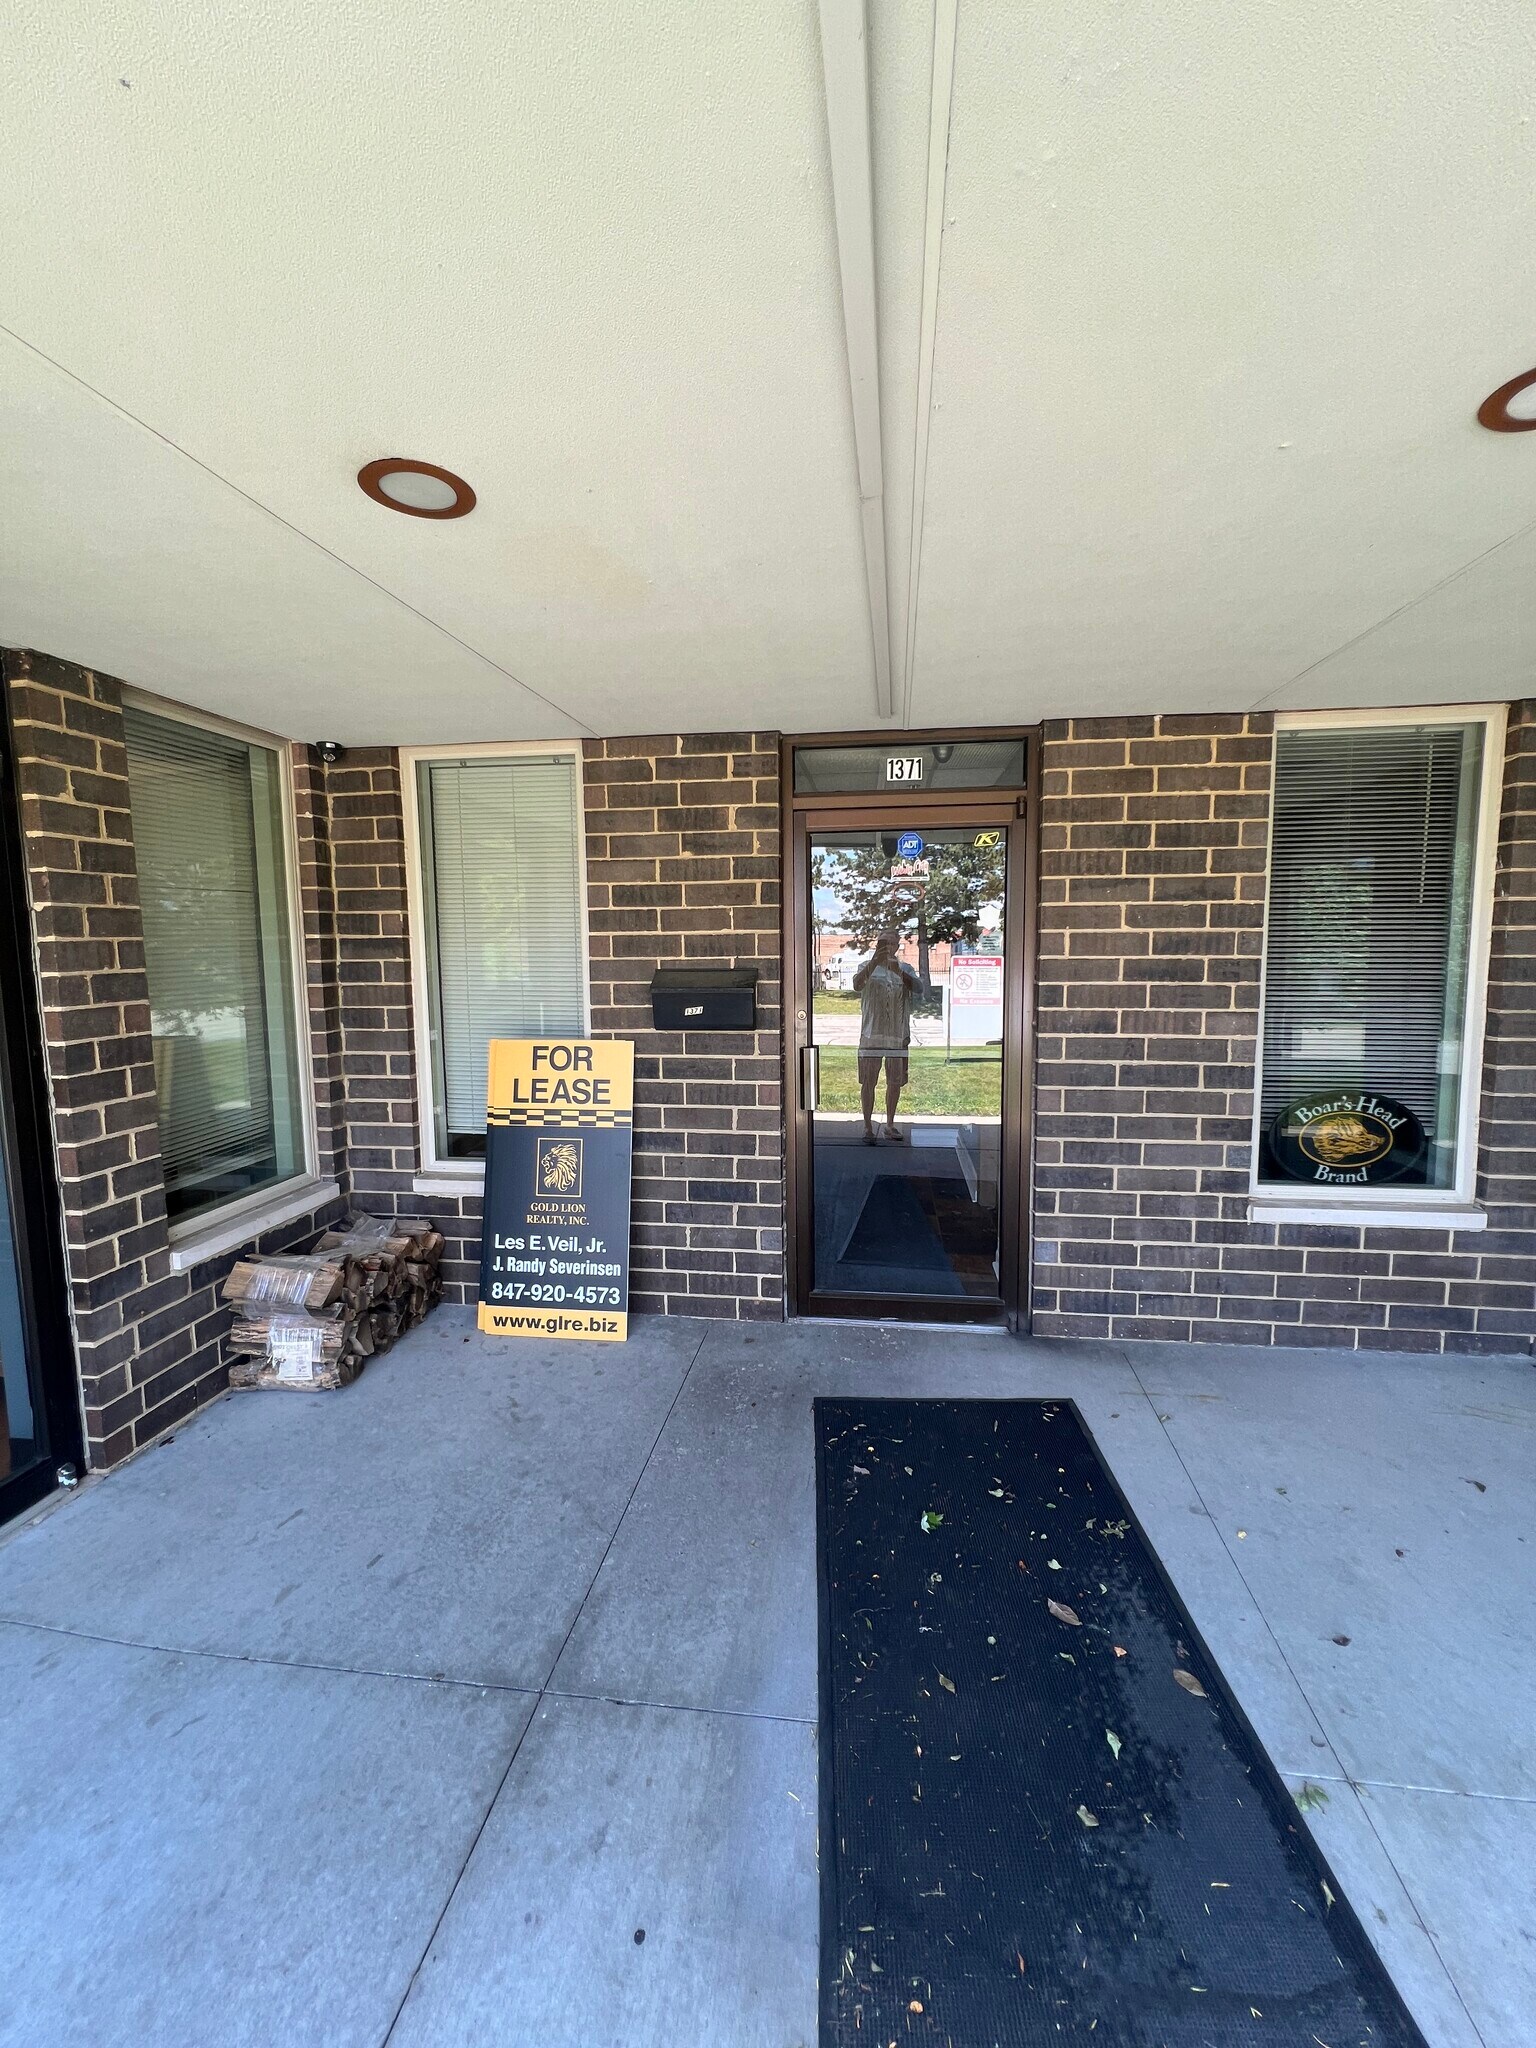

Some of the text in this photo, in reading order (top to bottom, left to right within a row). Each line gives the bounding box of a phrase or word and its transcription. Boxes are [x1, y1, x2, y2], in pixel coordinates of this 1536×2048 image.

[888, 758, 922, 780] 1371
[902, 840, 918, 850] ADT
[968, 959, 997, 967] Soliciting
[532, 1045, 593, 1072] FOR
[512, 1078, 611, 1105] LEASE
[1295, 1096, 1408, 1130] Boar's Head
[1313, 1164, 1368, 1183] Brand
[530, 1202, 586, 1213] GOLD LION
[526, 1214, 590, 1226] REALTY, INC.
[494, 1233, 607, 1255] Les E. Veil, Jr.
[492, 1256, 622, 1277] J. Randy Severinsen
[491, 1281, 621, 1305] 847-920-4573
[493, 1315, 618, 1334] www.glre.biz
